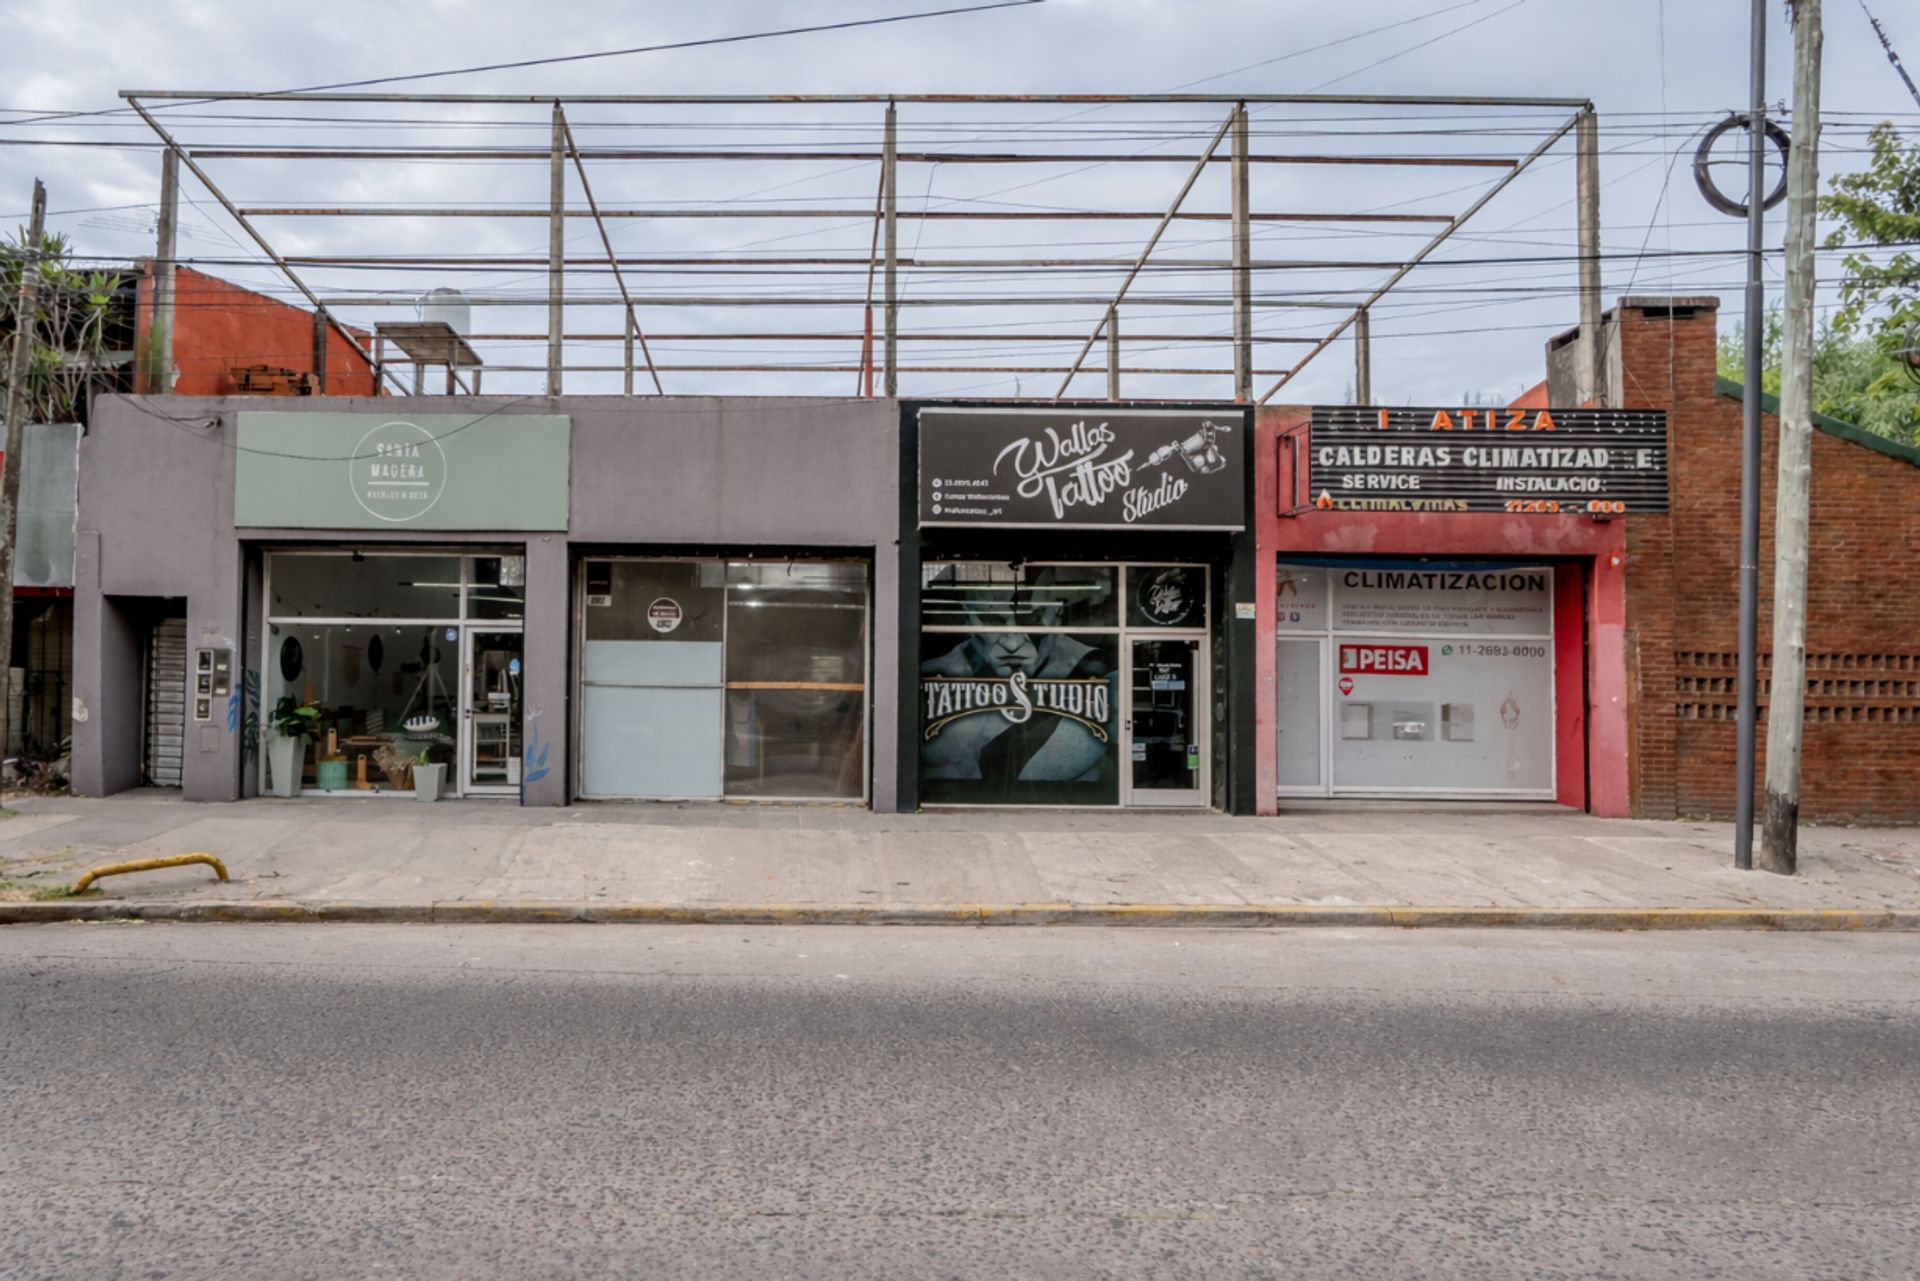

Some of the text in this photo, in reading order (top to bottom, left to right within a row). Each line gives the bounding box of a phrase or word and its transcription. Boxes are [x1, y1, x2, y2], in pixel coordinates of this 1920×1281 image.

[993, 421, 1115, 482] Wallas
[1318, 446, 1452, 467] CALDERAS
[371, 463, 424, 478] MADERA
[1341, 474, 1421, 490] SERVICE
[1044, 449, 1134, 519] Tattoo
[1122, 472, 1189, 522] Studio
[1343, 570, 1545, 592] CLIMATIZACION
[1359, 648, 1424, 672] PEISA
[922, 682, 1007, 719] TATTOO
